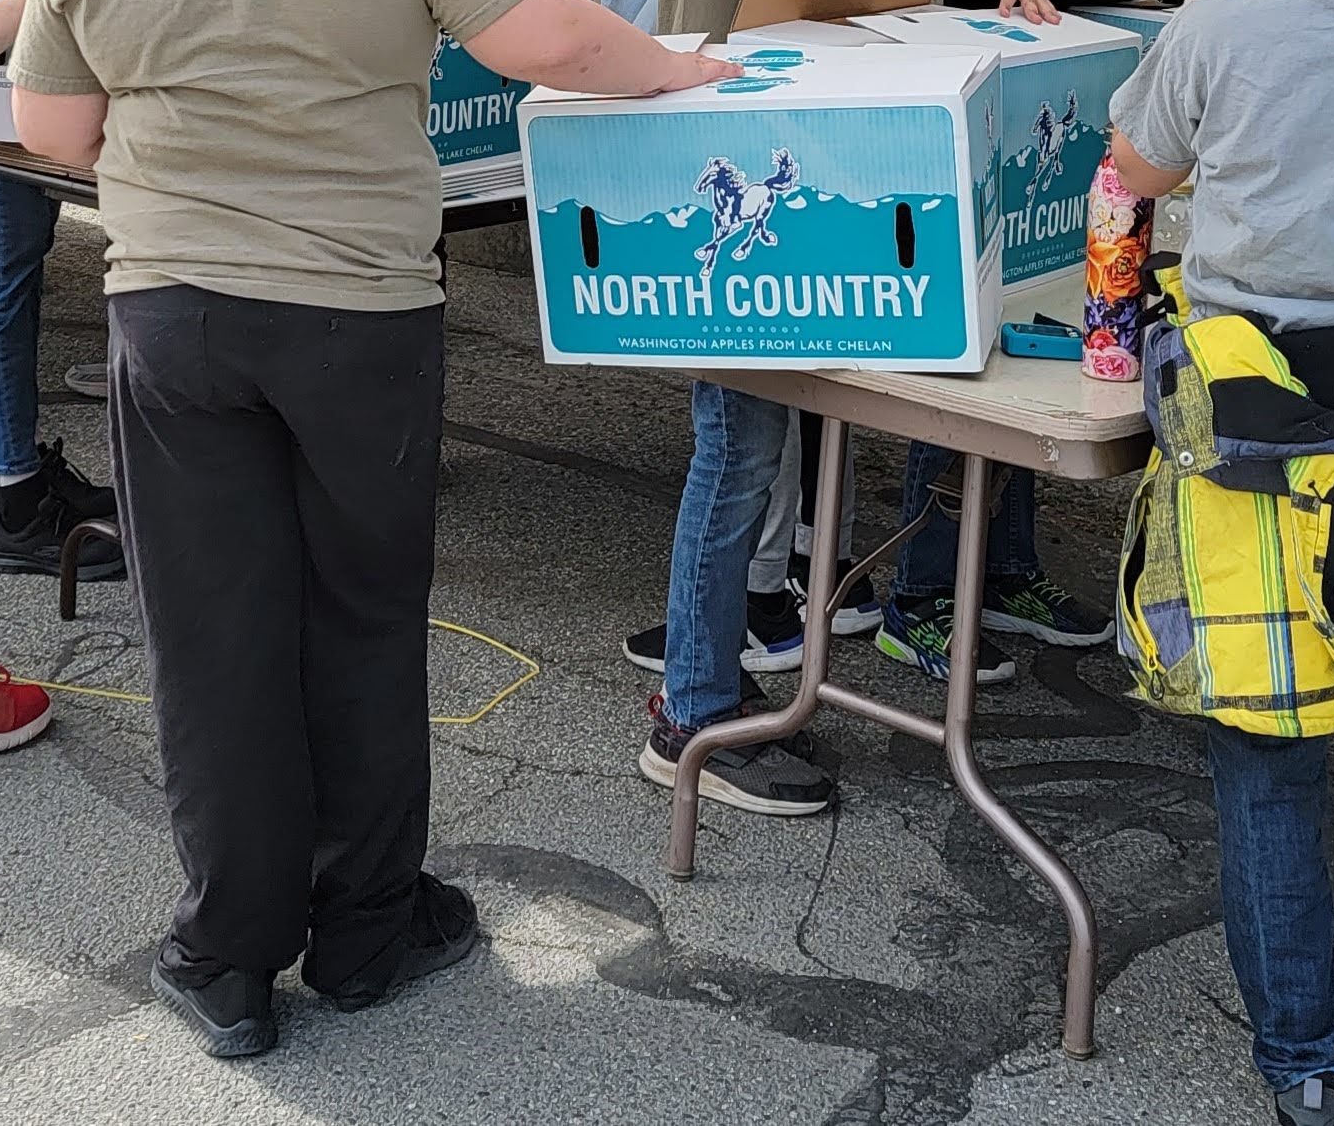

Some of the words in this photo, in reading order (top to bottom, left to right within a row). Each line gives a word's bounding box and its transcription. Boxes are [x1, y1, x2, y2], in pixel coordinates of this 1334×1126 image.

[426, 90, 516, 137] OUNTRY
[446, 148, 464, 160] LAKE
[466, 143, 494, 157] CHELAN
[1034, 193, 1089, 242] COUN
[572, 273, 713, 317] NORTH
[725, 274, 931, 318] COUNTRY
[618, 337, 707, 350] WASHINGTON
[710, 339, 755, 351] APPLES
[760, 339, 796, 351] FROM
[800, 339, 833, 352] LAKE
[837, 339, 893, 352] CHELAN
